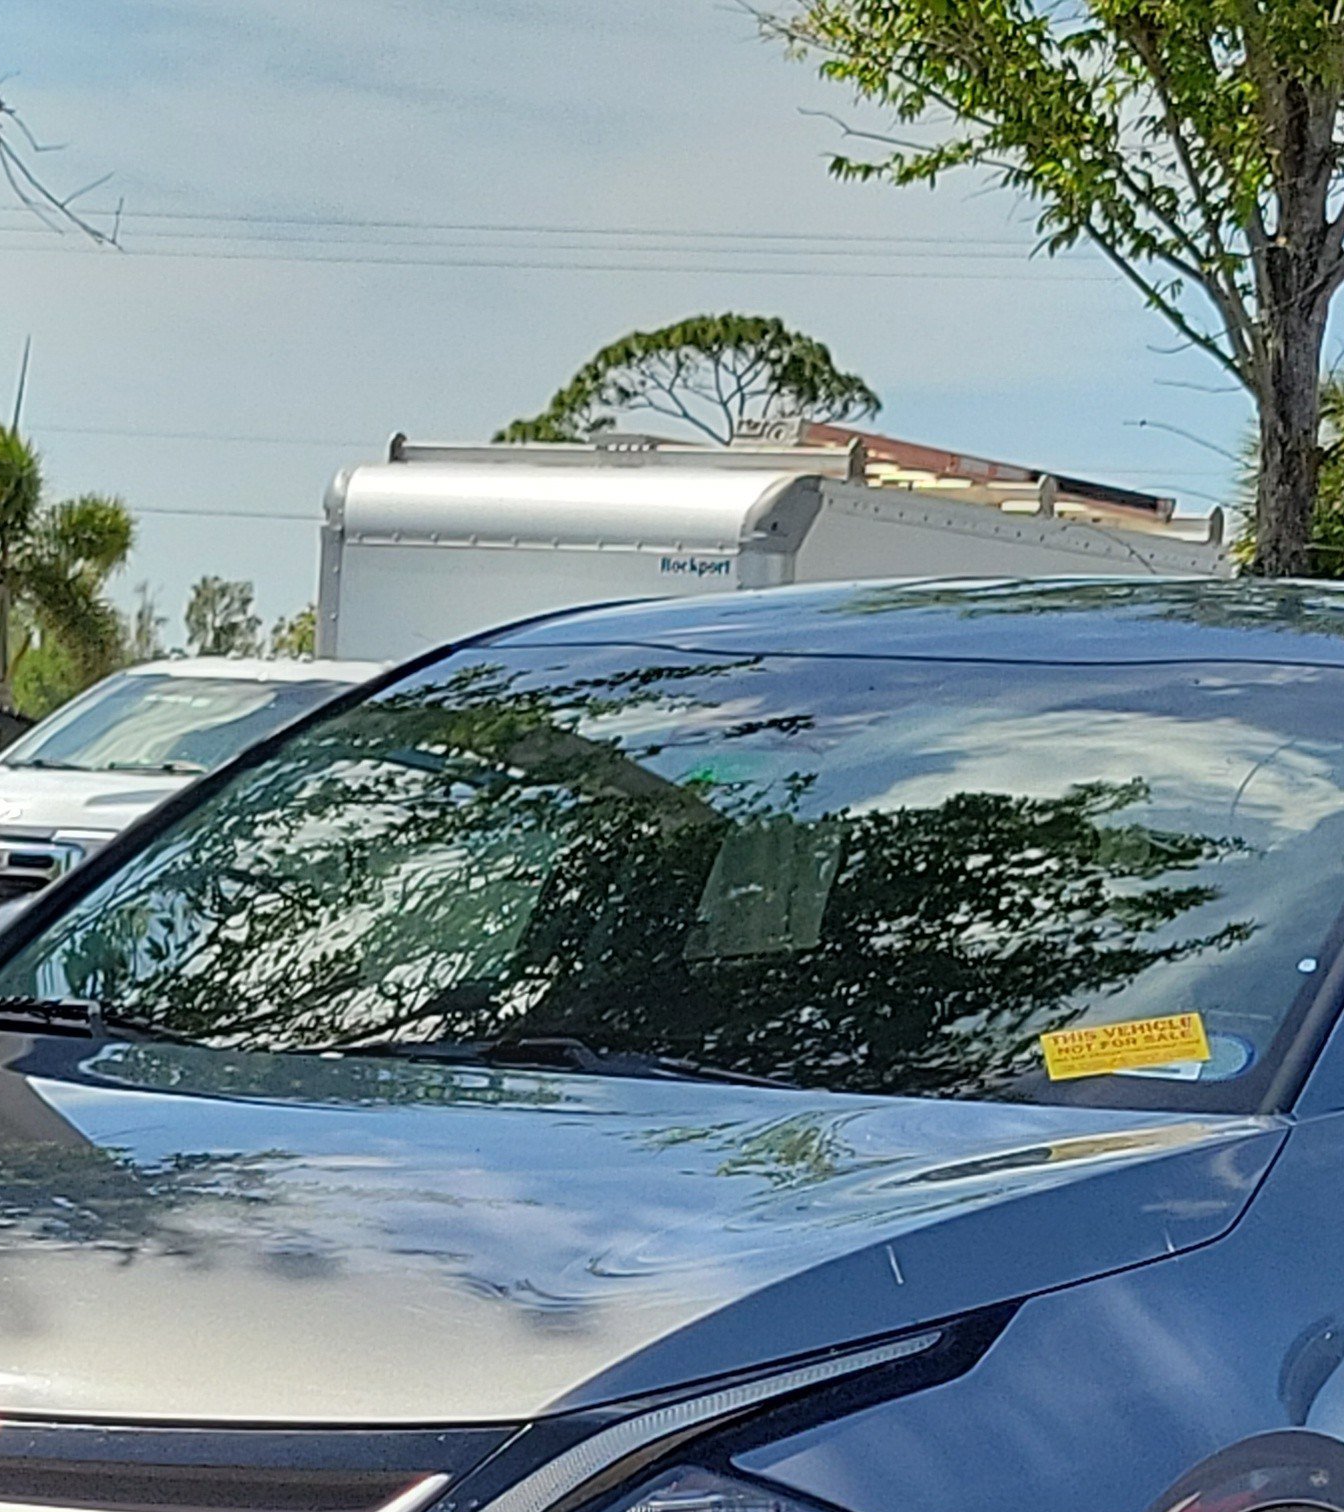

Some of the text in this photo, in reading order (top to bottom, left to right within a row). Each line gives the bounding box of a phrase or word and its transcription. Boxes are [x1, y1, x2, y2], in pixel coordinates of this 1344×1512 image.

[660, 555, 730, 577] Rockport
[1051, 1016, 1192, 1046] THIS VEHICLE
[1057, 1042, 1093, 1056] NOT
[1100, 1036, 1138, 1050] FOR
[1143, 1029, 1190, 1044] SALE
